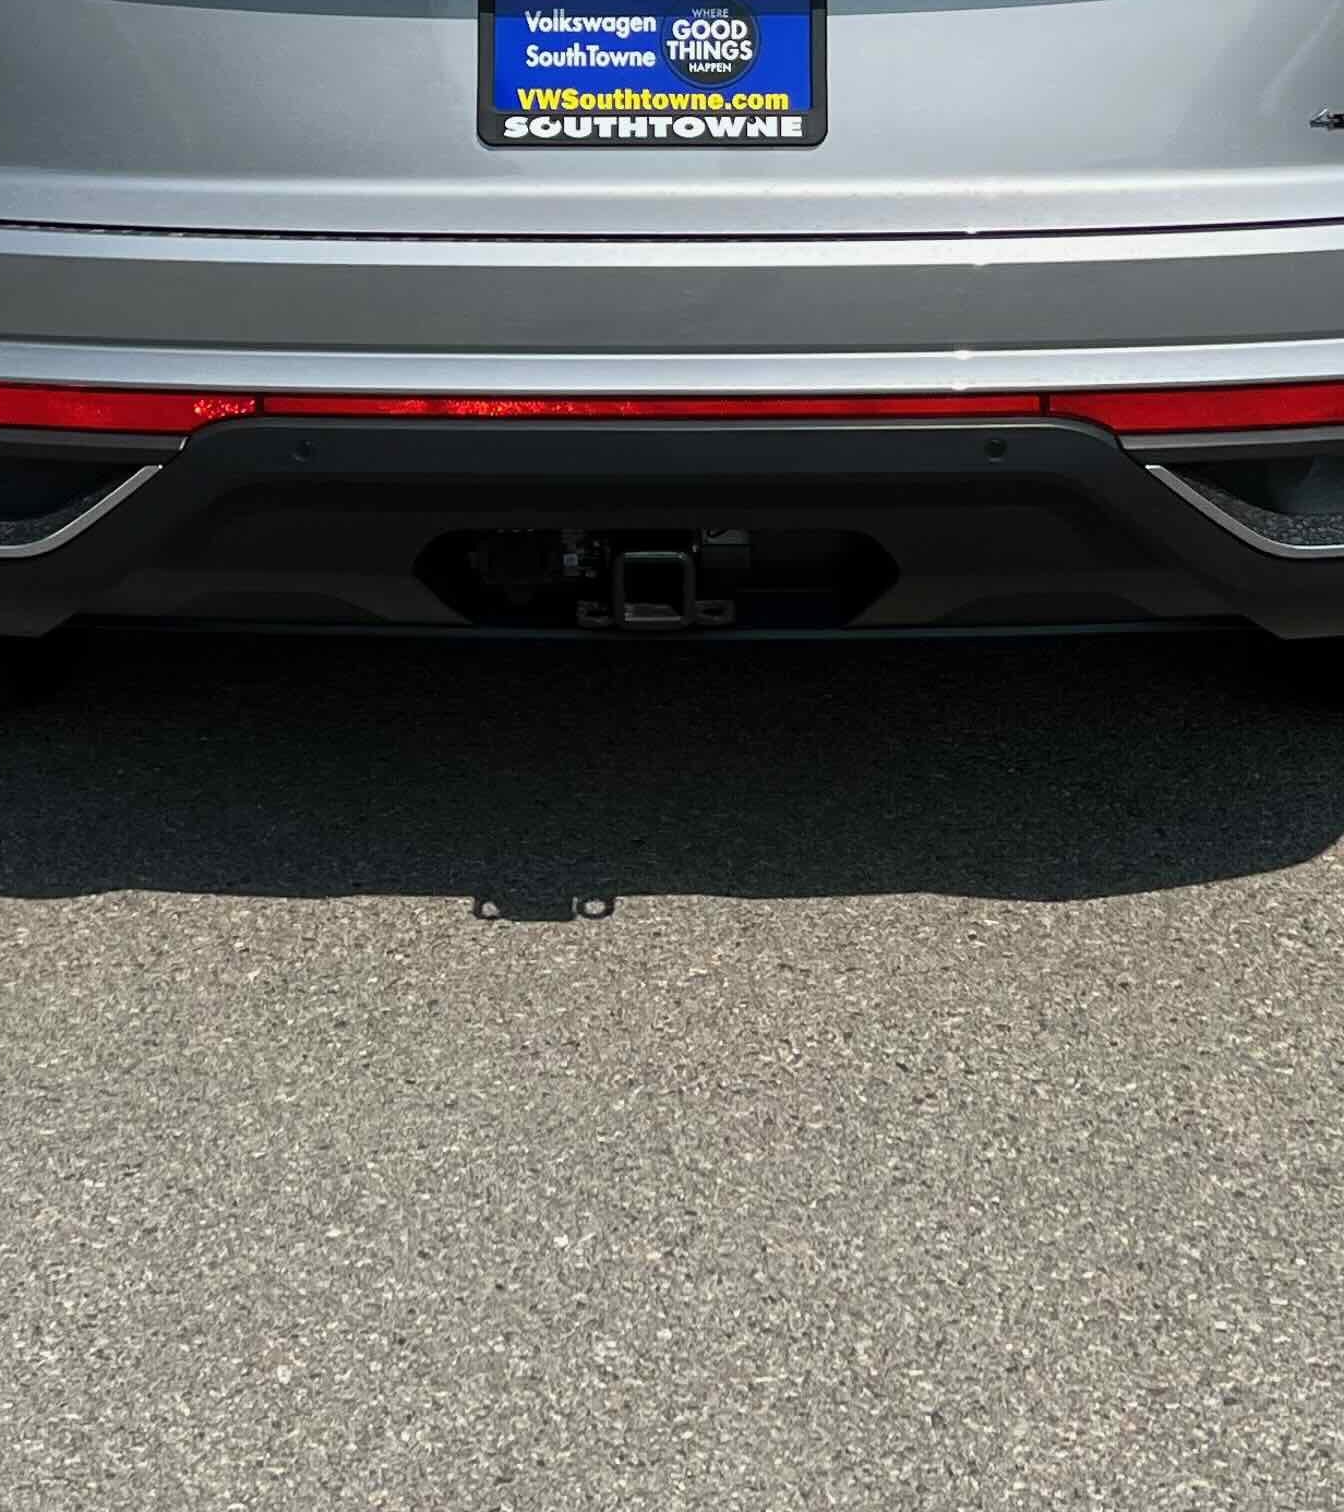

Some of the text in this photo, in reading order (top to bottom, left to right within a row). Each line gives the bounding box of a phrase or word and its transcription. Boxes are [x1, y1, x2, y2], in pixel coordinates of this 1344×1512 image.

[525, 8, 657, 38] Volkswagen
[691, 8, 729, 18] WHERE
[672, 19, 748, 40] GOOD
[525, 43, 656, 68] SouthTowne
[666, 40, 753, 61] THINGS
[688, 62, 732, 73] HAPPEN
[517, 89, 790, 111] VWSouthtowne.com
[503, 116, 803, 139] SOUTHTOWNE
